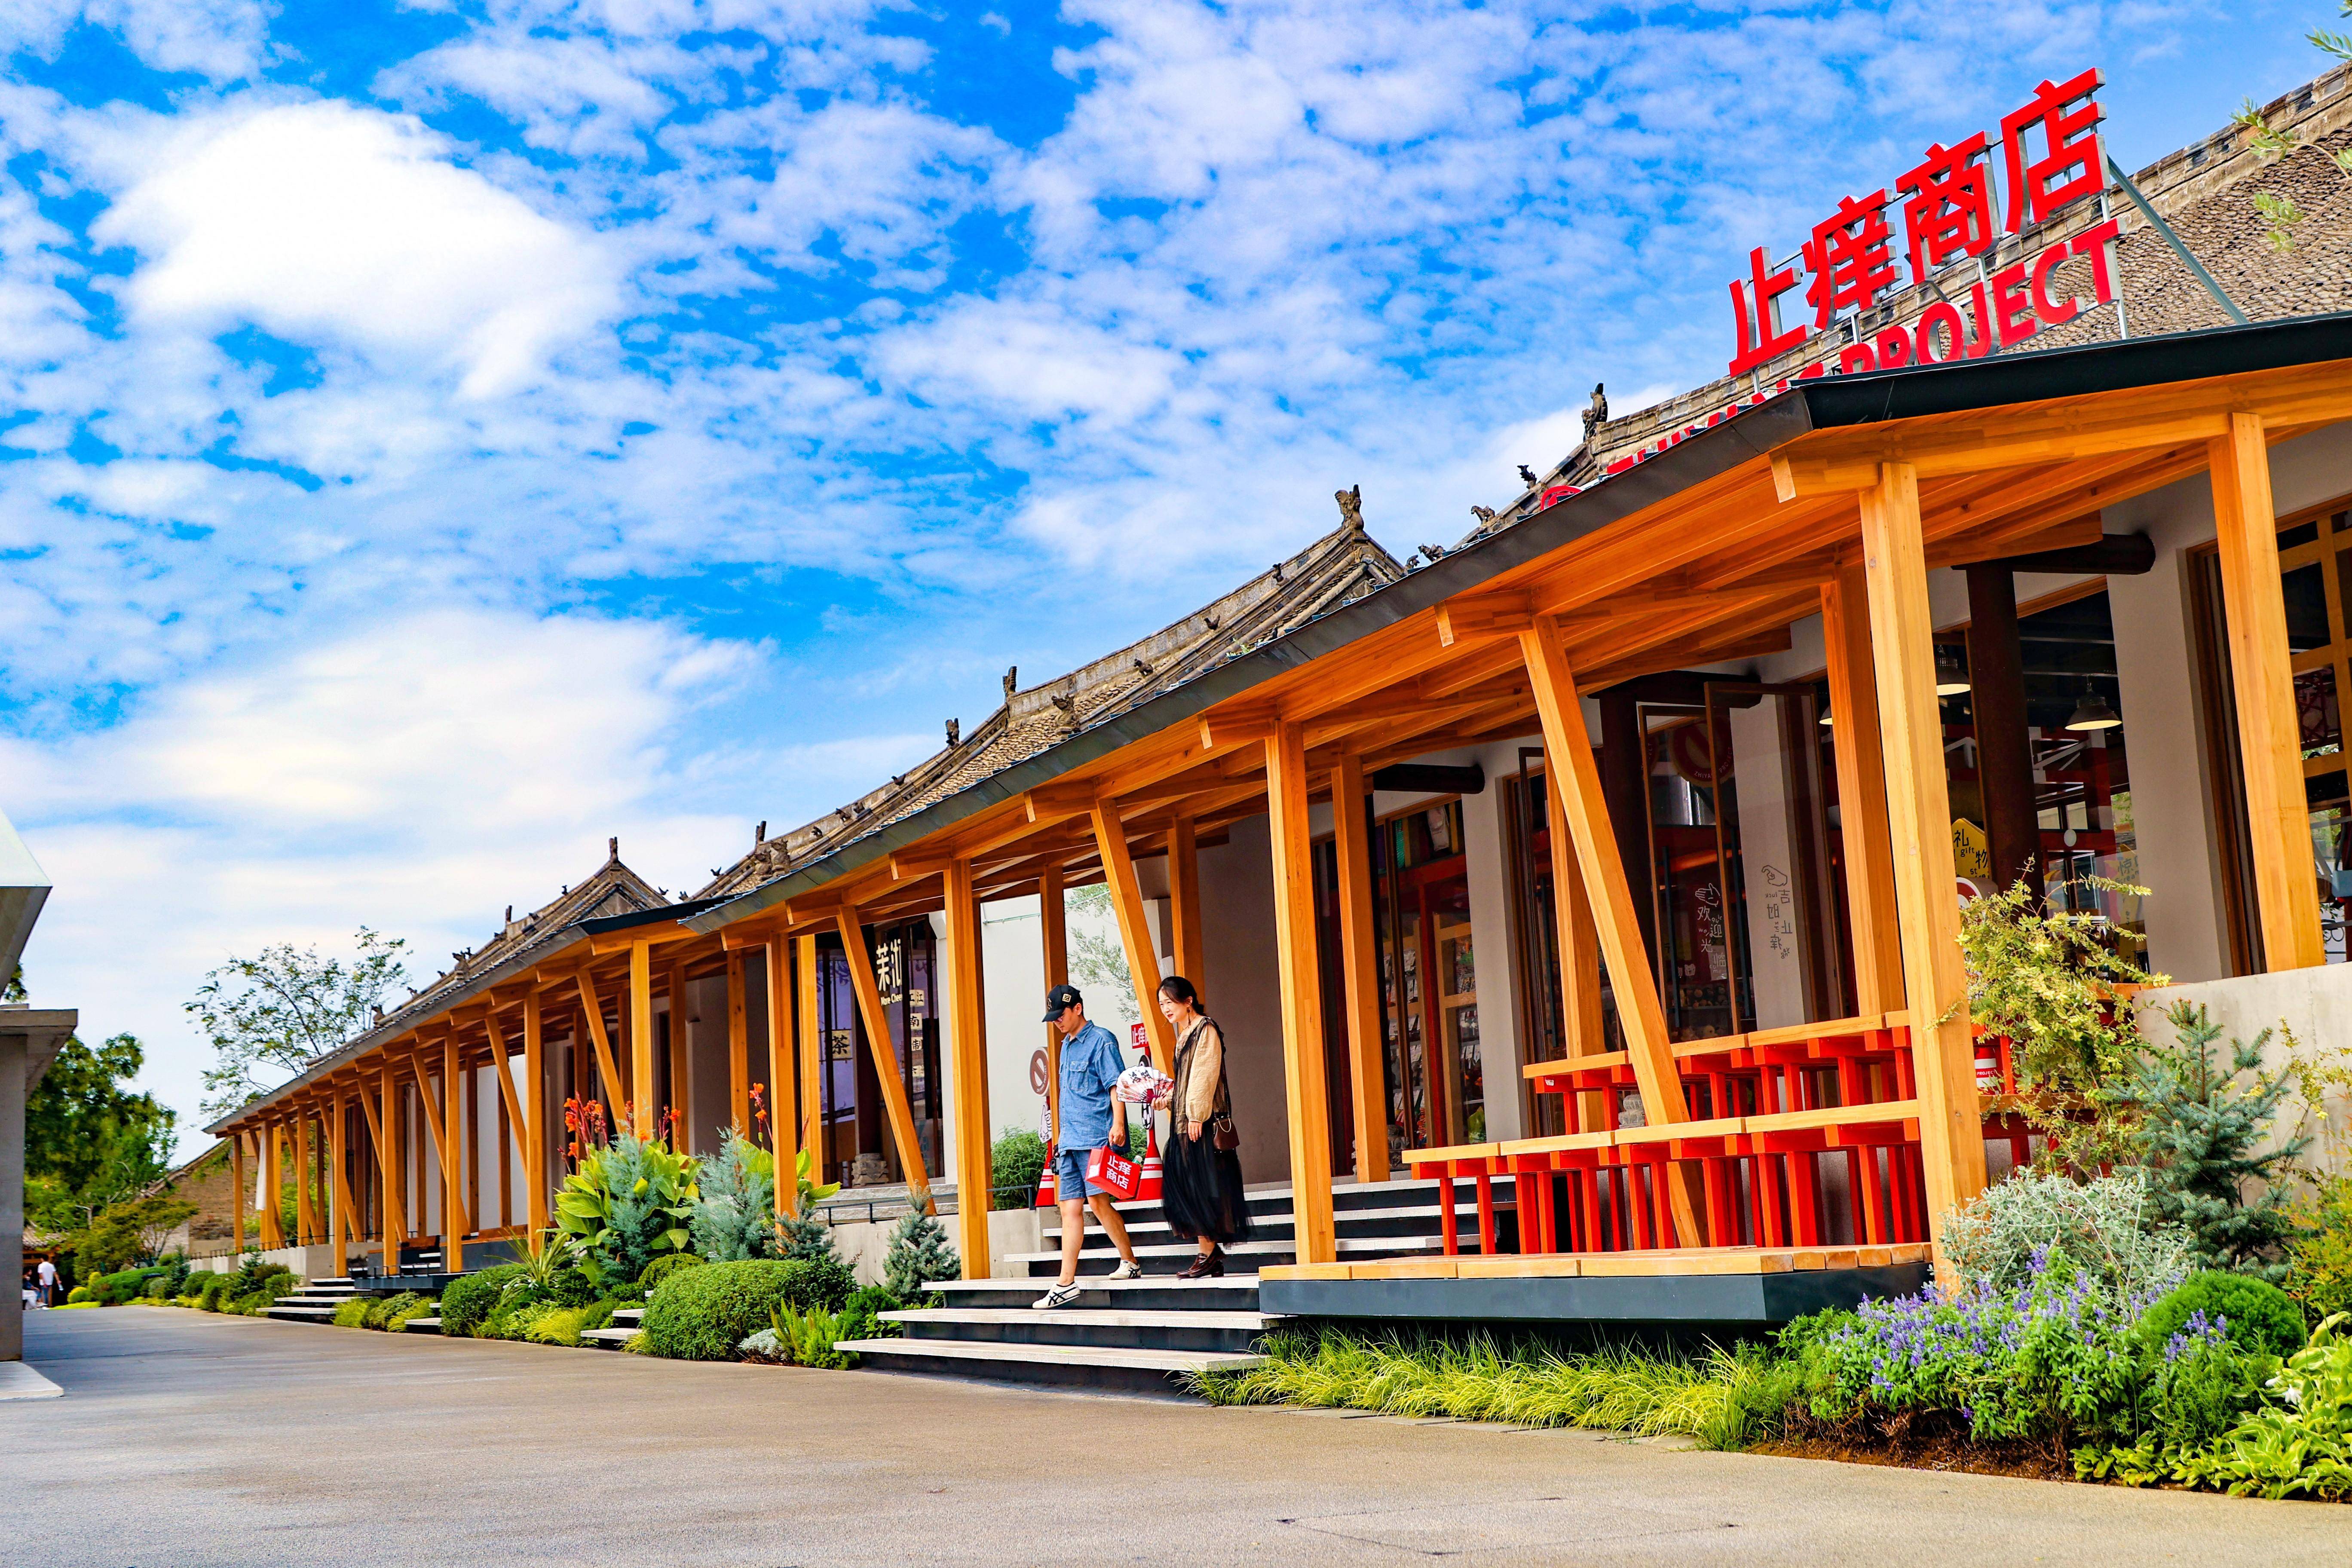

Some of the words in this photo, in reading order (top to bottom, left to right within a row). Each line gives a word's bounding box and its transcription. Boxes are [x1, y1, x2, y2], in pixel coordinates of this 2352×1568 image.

[1729, 67, 2104, 377] 止痒商店
[1840, 218, 2126, 373] PROJECT
[1960, 846, 1975, 857] gift
[832, 1035, 849, 1055] 茶
[1132, 1026, 1148, 1046] 止痒
[1107, 1155, 1132, 1176] 止痒
[1106, 1167, 1130, 1190] 商店
